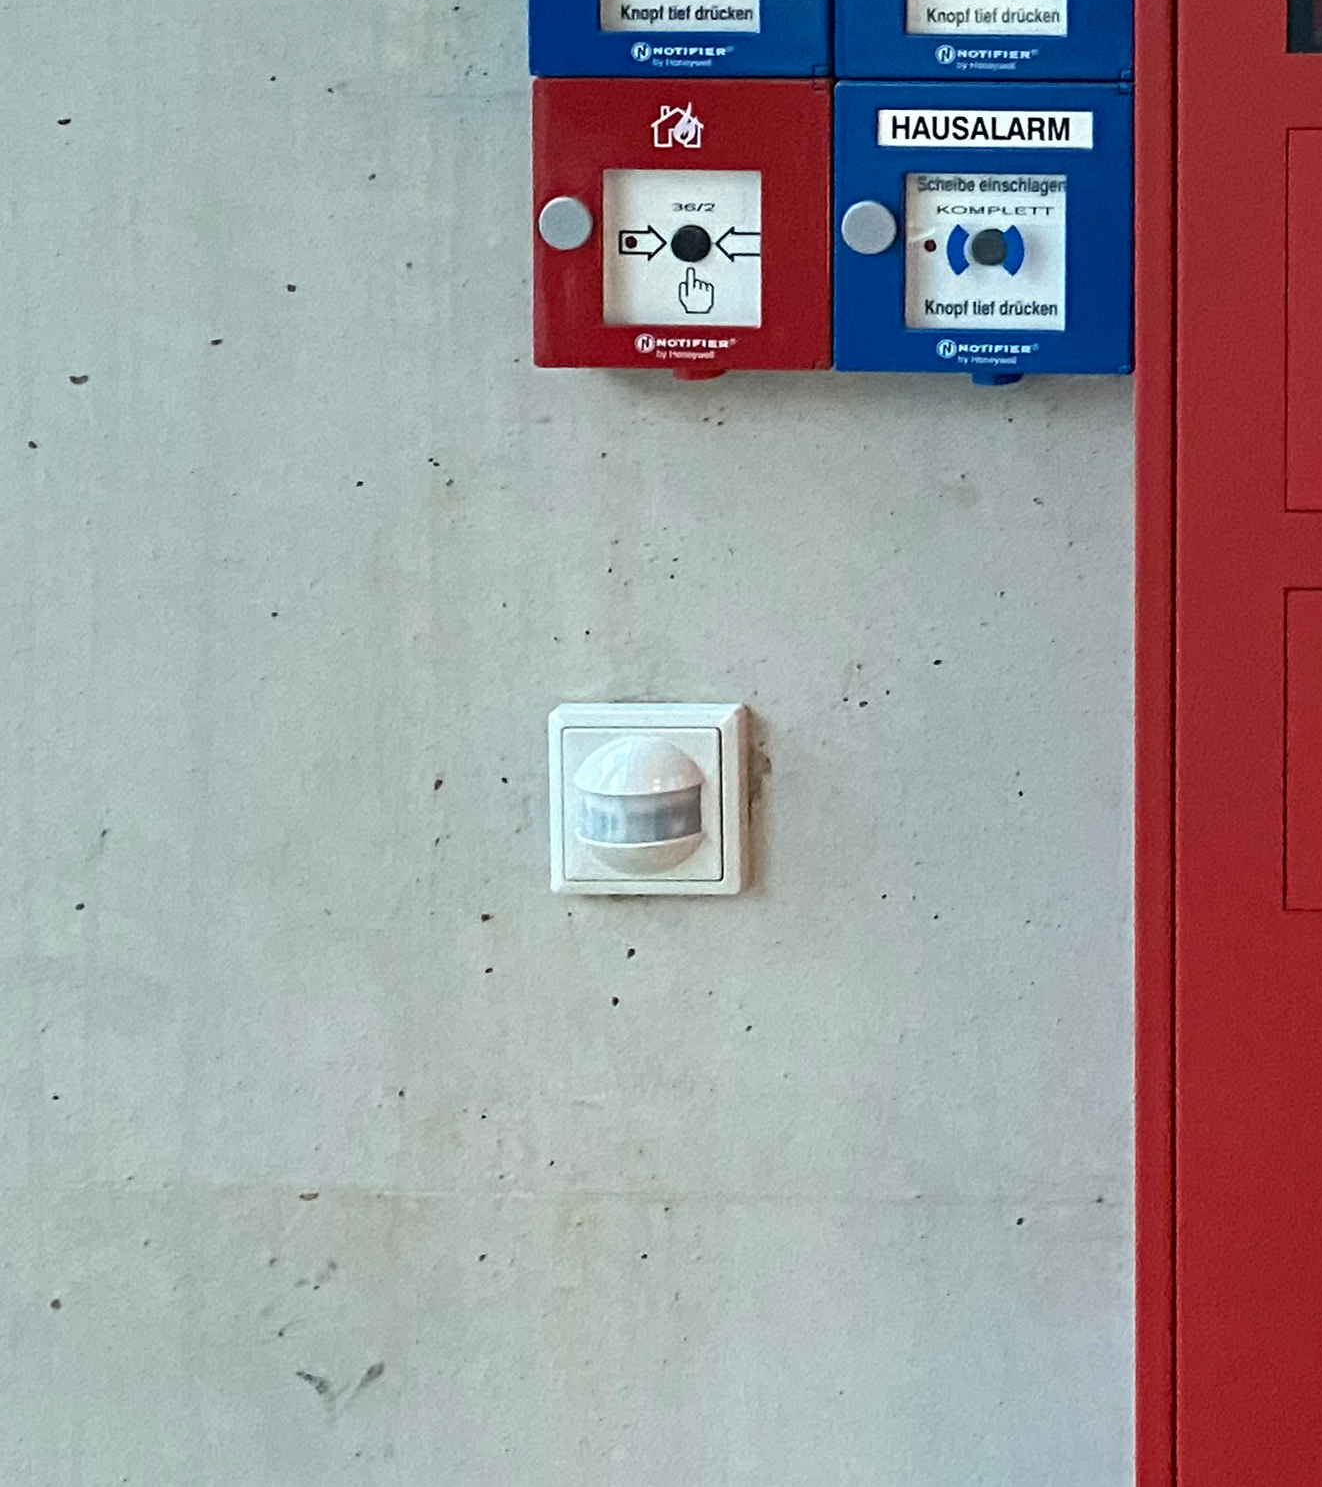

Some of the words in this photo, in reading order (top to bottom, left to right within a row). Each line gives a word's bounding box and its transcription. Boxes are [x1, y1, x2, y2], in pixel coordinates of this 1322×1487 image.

[620, 4, 664, 24] Knopf
[668, 4, 692, 21] tief
[695, 4, 754, 21] drücken
[926, 8, 970, 27] Knopf
[974, 8, 997, 24] tief
[1001, 8, 1060, 24] drücken
[891, 115, 1071, 141] HAUSALARM
[917, 176, 975, 193] Scheibe
[671, 202, 715, 213] 36/2
[936, 204, 1055, 216] KOMPLETT
[924, 298, 968, 319] Knopf
[972, 299, 995, 316] tief
[999, 299, 1058, 316] drücken
